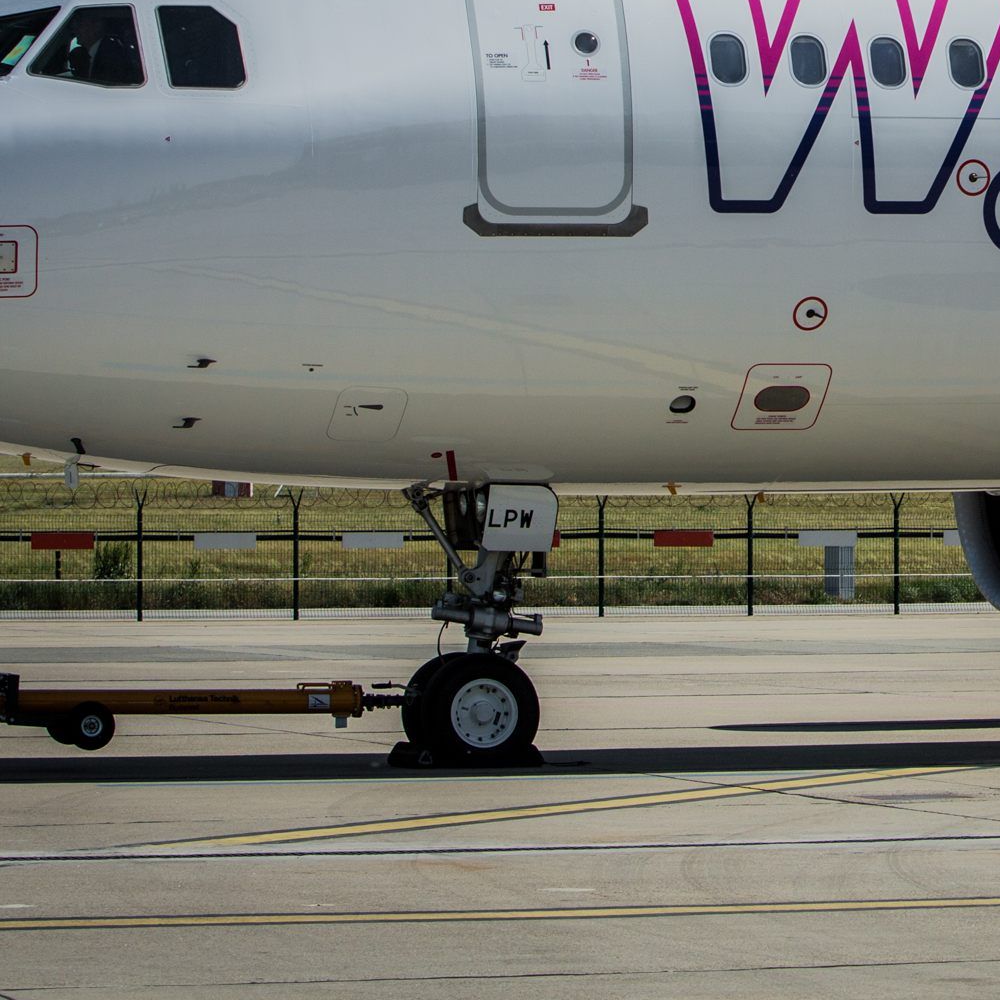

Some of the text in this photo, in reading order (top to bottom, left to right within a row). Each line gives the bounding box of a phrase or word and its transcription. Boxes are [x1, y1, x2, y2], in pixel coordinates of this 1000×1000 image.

[488, 509, 534, 528] LPW
[169, 694, 241, 703] Lufthansa Technik
